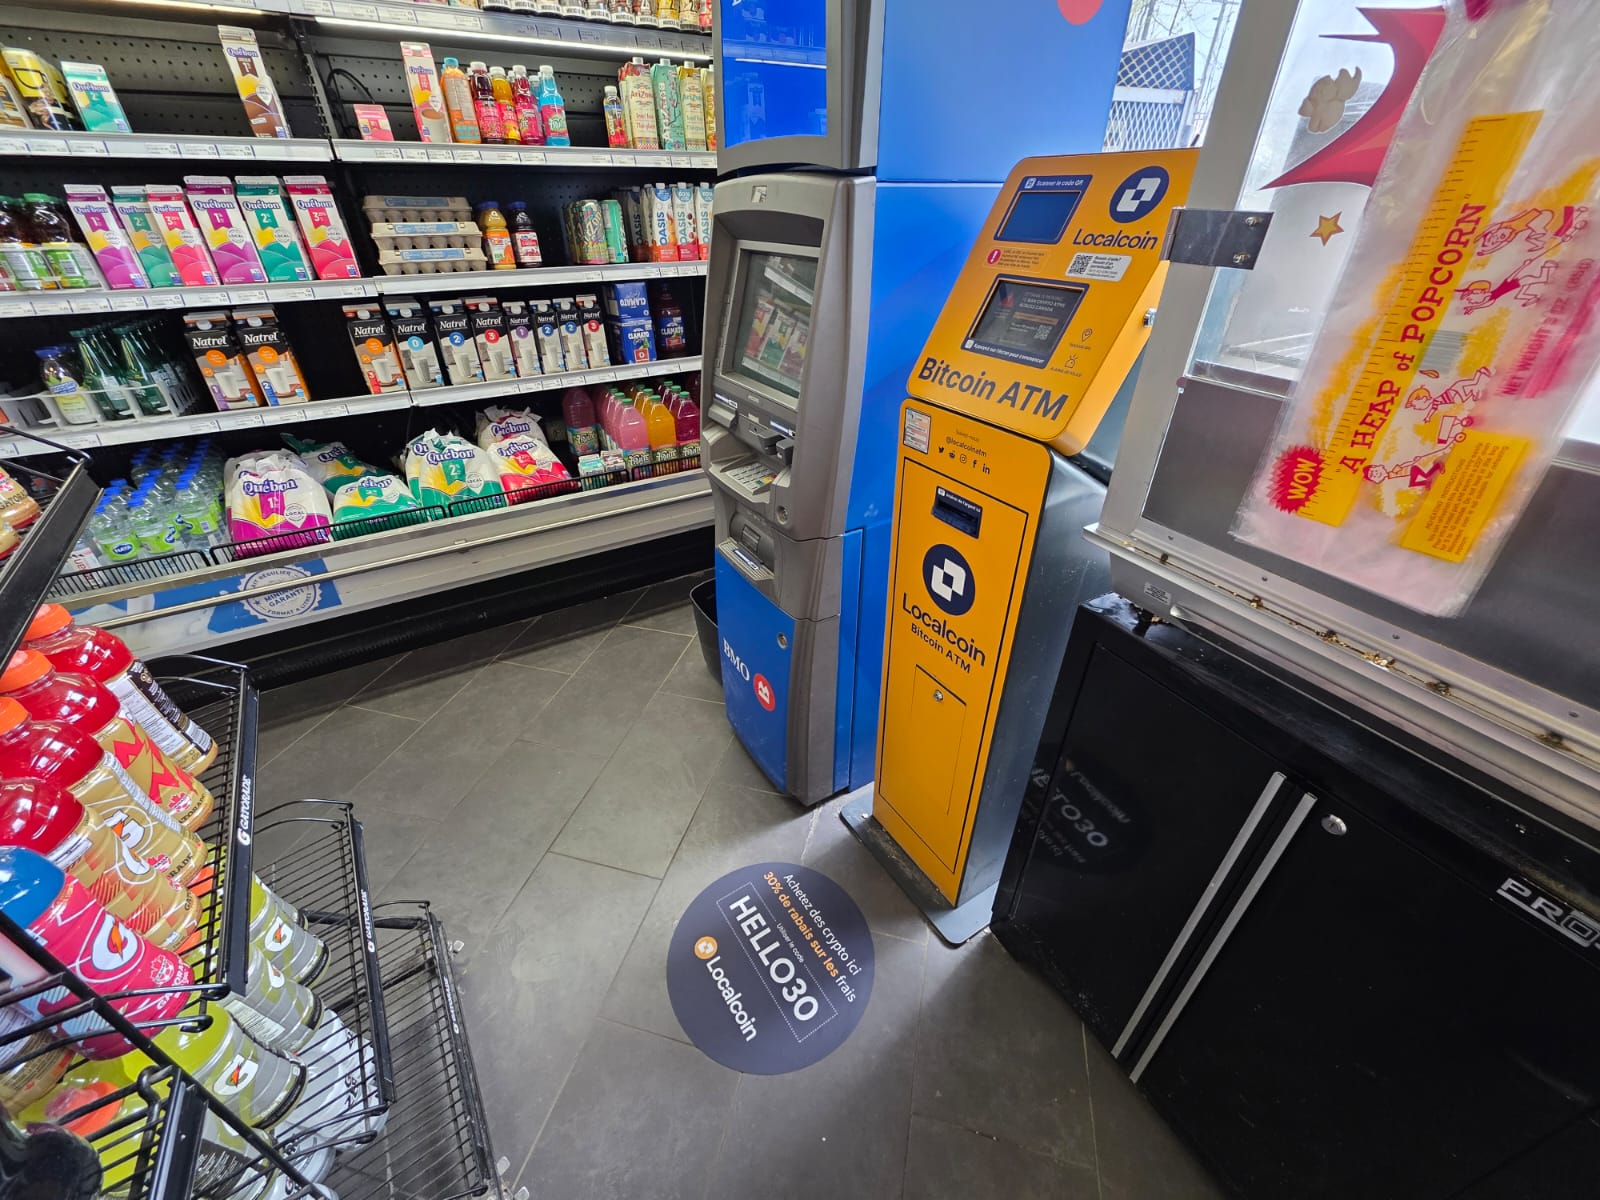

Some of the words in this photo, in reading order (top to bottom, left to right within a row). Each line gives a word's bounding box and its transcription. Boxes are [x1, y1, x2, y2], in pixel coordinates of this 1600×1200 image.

[194, 199, 235, 210] Québon
[243, 199, 280, 210] Québon
[297, 199, 333, 209] Québon
[657, 211, 668, 246] OASIS
[678, 212, 688, 245] OASIS
[1073, 229, 1159, 250] Localcoin
[1400, 202, 1487, 343] POPCORN
[354, 325, 385, 336] Natrel
[397, 323, 425, 333] Natrel
[440, 320, 467, 330] Natrel
[476, 316, 501, 327] Natrel
[193, 336, 228, 347] Natrel
[244, 332, 278, 343] Natrel
[628, 331, 650, 340] CLAMATO
[1393, 351, 1415, 371] of
[918, 357, 996, 400] Bitcoin
[996, 381, 1069, 421] ATM
[1350, 379, 1400, 449] HEAP
[426, 449, 475, 465] Québon
[946, 436, 987, 457] @localcoinatm
[1340, 455, 1368, 475] A
[243, 478, 298, 497] Québon
[1287, 457, 1317, 500] WOW
[269, 588, 306, 608] GARANTI
[902, 592, 986, 667] Localcoin
[723, 636, 750, 681] BMO
[911, 623, 944, 654] Bitcoin
[945, 650, 970, 674] ATM
[241, 773, 254, 828] GATORADE
[237, 827, 251, 846] G
[360, 888, 373, 940] GATORADE
[783, 874, 813, 911] Achetez
[809, 908, 826, 929] des
[822, 927, 849, 961] crypto
[846, 959, 863, 976] ici
[763, 871, 783, 894] 30%
[778, 893, 791, 908] de
[788, 906, 814, 941] rabais
[810, 940, 827, 958] sur
[823, 957, 839, 978] les
[835, 975, 857, 1003] frais
[729, 895, 819, 1021] HELLO30
[706, 956, 757, 1042] Localcoin
